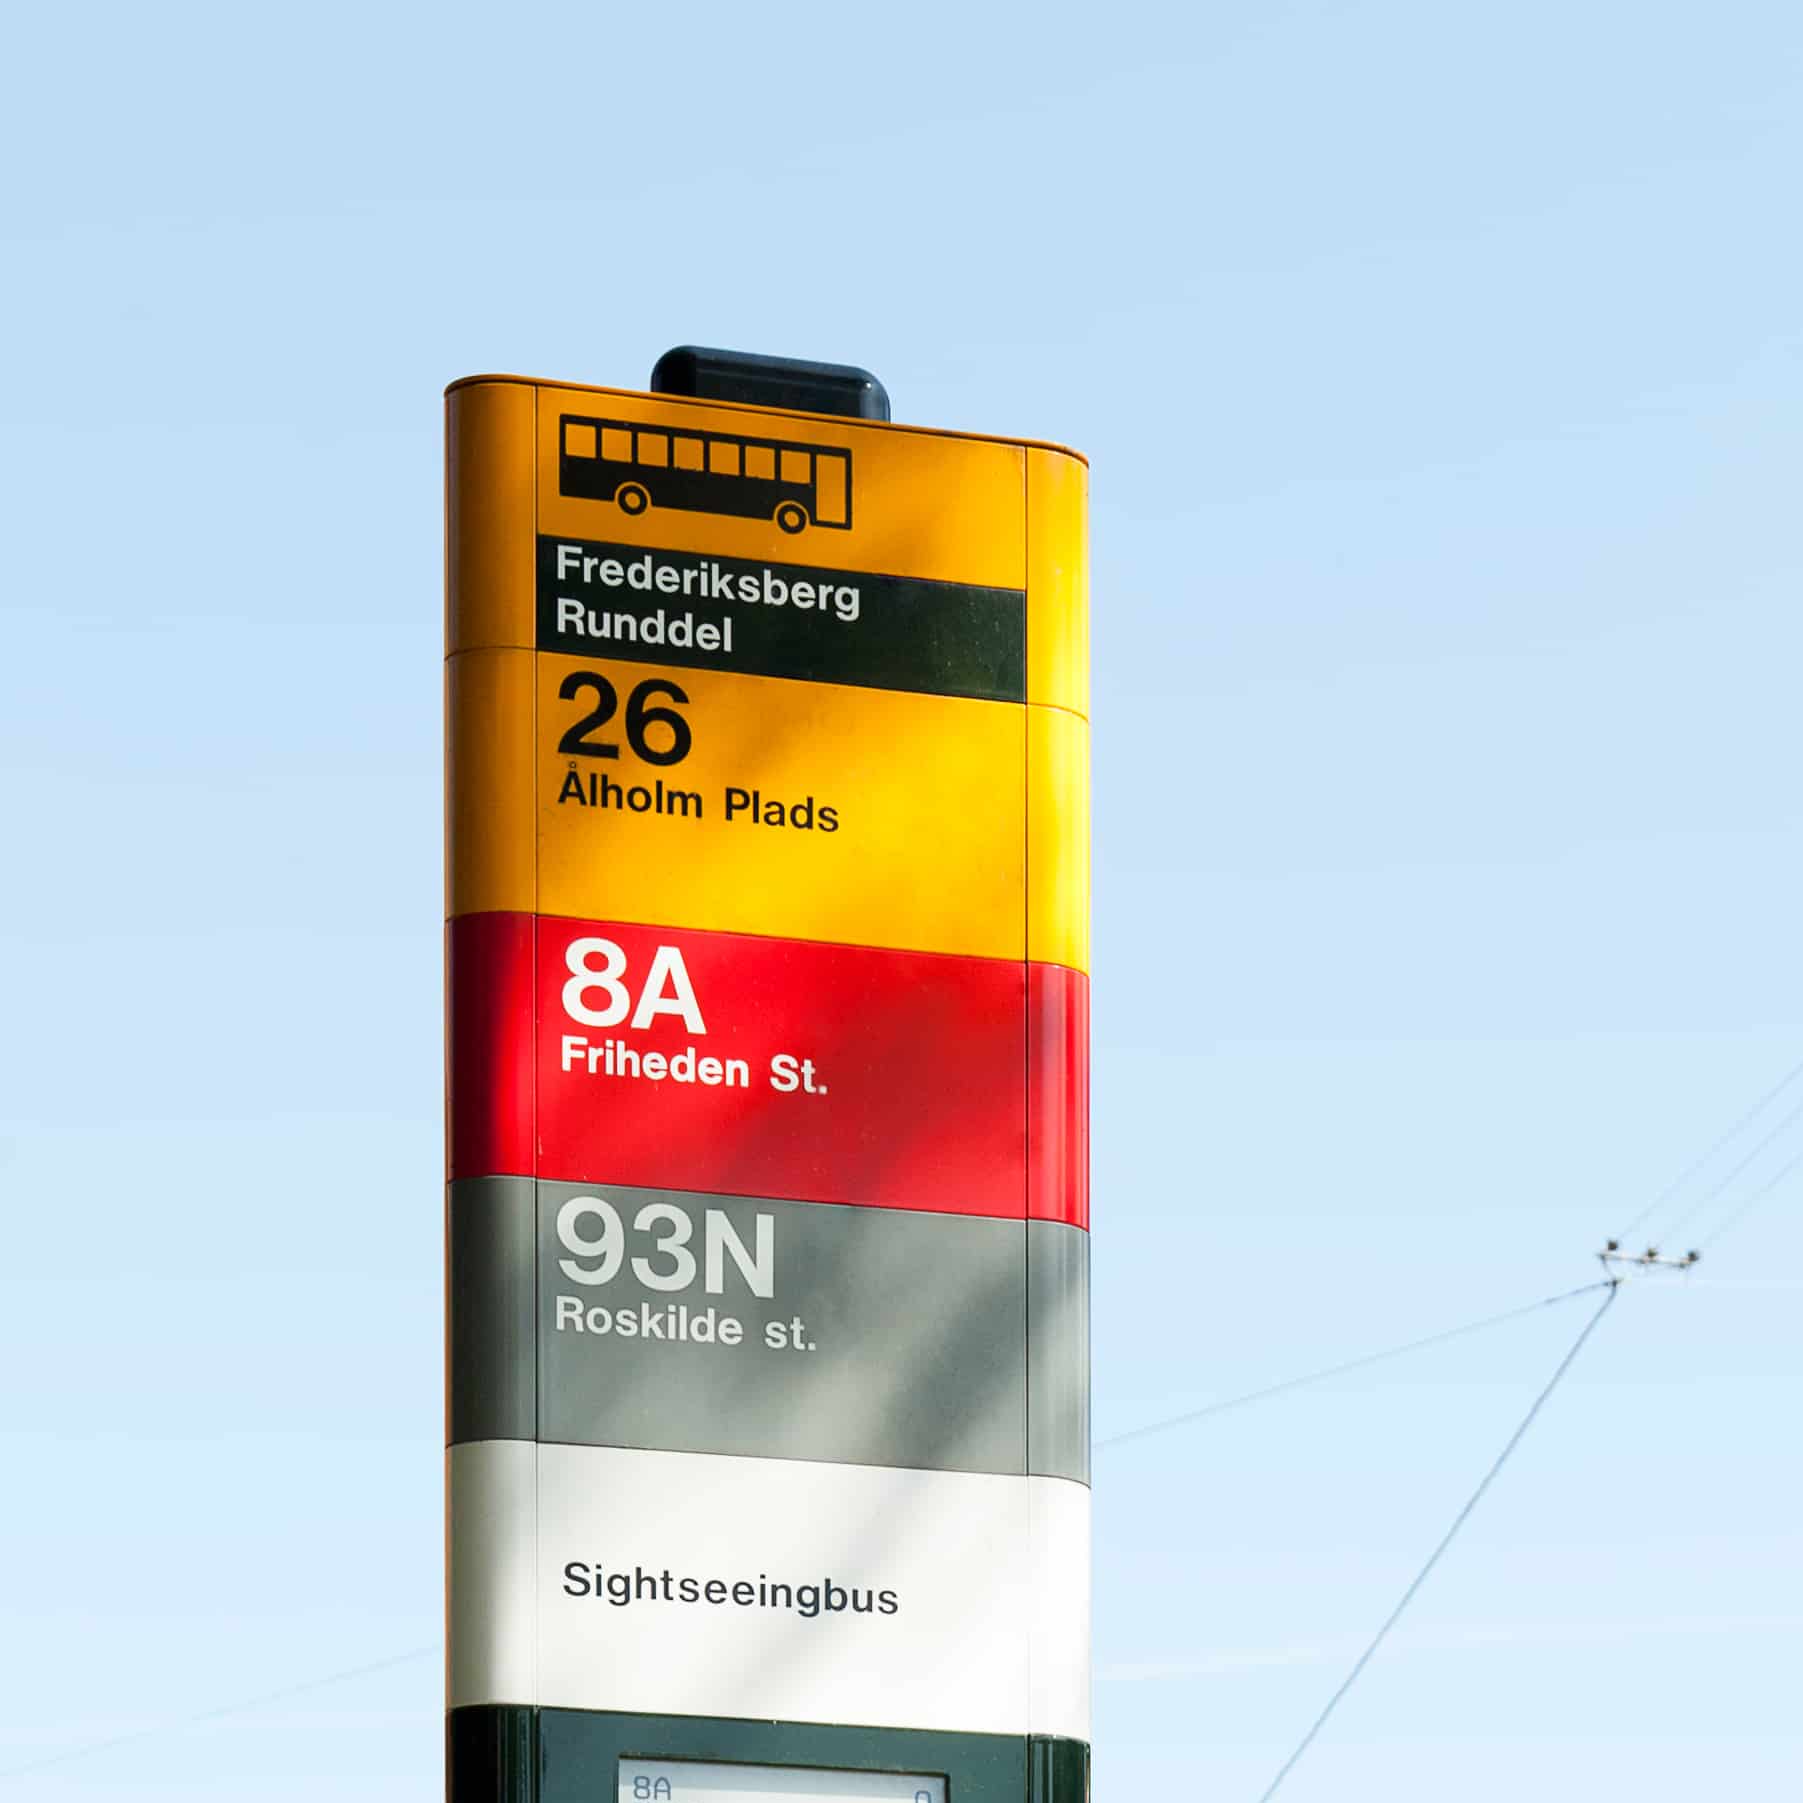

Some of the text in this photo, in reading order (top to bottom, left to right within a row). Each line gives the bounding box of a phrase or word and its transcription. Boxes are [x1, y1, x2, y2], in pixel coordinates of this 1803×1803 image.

[557, 545, 860, 622] Frederiksberg
[557, 597, 733, 652] Runddel
[556, 670, 693, 767] 26
[558, 761, 840, 832] Ålholm Plads
[561, 937, 707, 1034] 8A
[561, 1035, 828, 1095] Friheden St.
[556, 1195, 775, 1299] 93N
[556, 1295, 817, 1351] Roskilde st.
[563, 1561, 899, 1617] Sightseeingbus
[632, 1775, 672, 1800] 8A
